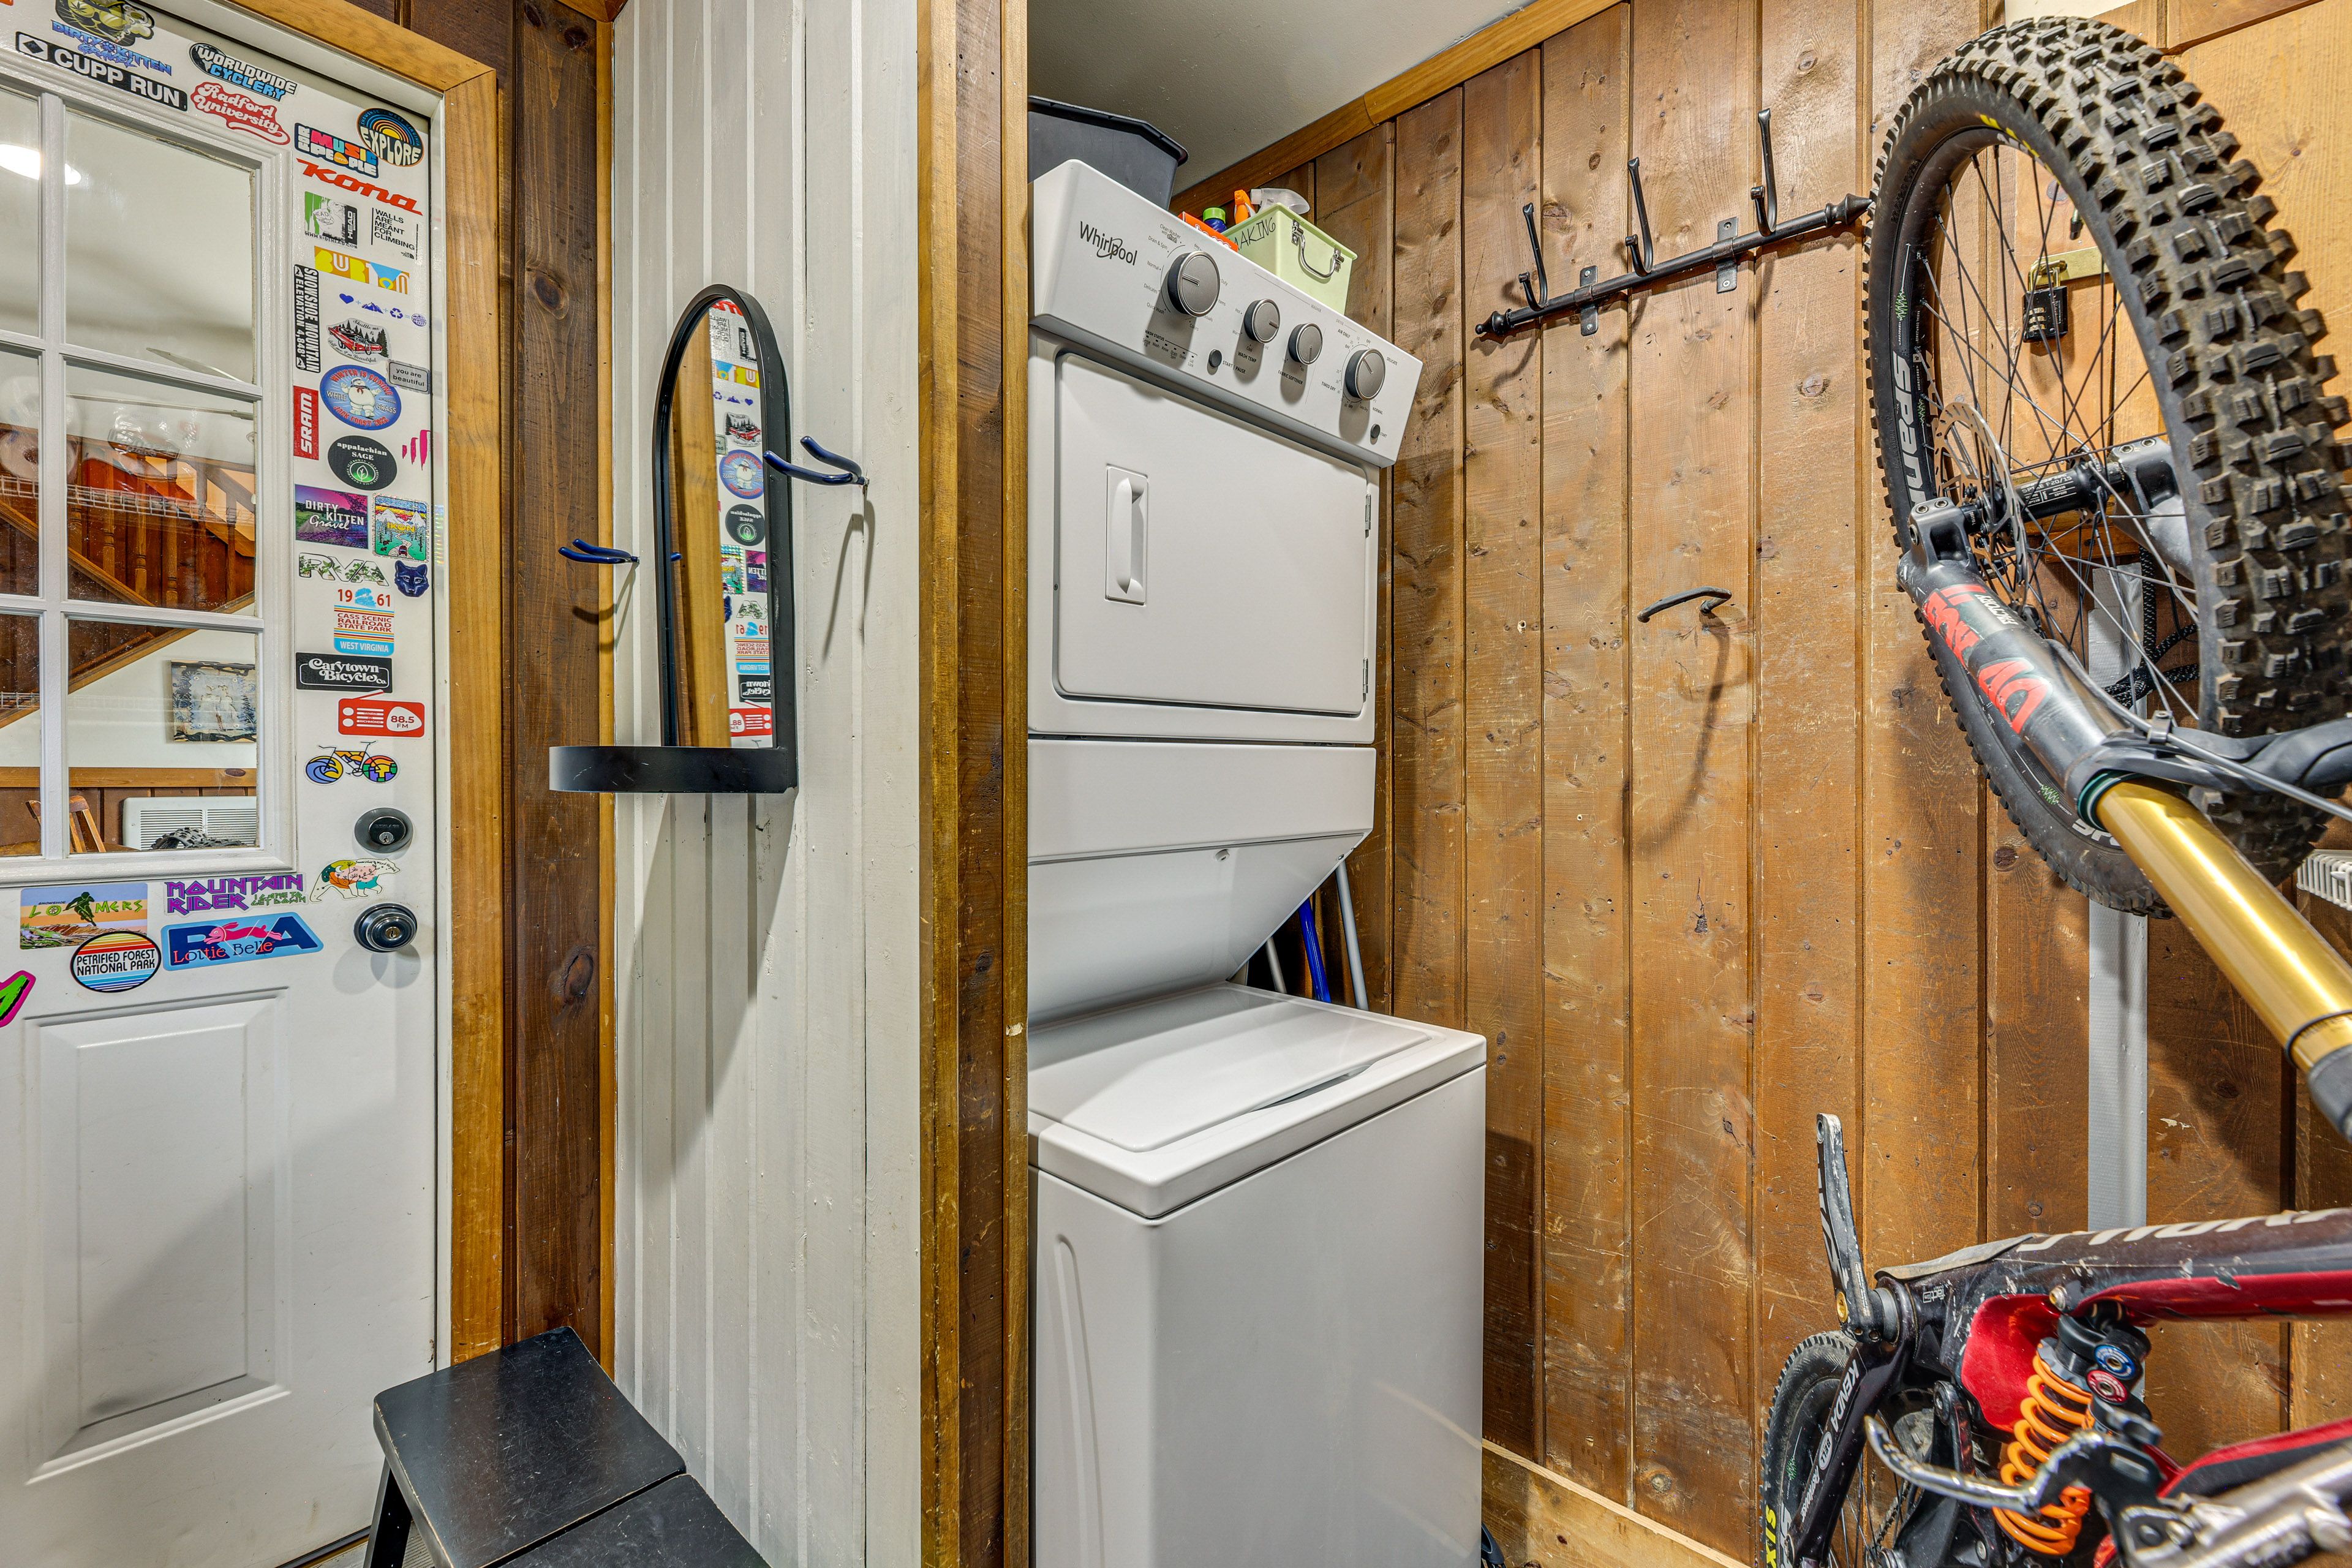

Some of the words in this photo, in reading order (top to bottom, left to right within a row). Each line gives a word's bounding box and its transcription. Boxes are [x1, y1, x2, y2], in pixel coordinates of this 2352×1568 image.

[50, 19, 103, 45] DIRTY
[116, 45, 172, 76] KITTEN
[197, 45, 297, 94] WORLDWIDE
[55, 48, 123, 84] CUPP
[130, 75, 179, 107] RUN
[209, 64, 285, 101] CYCLERY
[197, 83, 274, 118] Radford
[193, 95, 279, 135] University
[311, 130, 377, 166] MUSIC
[360, 126, 421, 166] EXPLORE
[375, 209, 404, 224] WALLS
[375, 216, 393, 225] ARE
[375, 221, 404, 235] MEANT
[375, 226, 391, 236] FOR
[1159, 224, 1169, 232] Clean
[1169, 228, 1181, 239] Washer
[374, 232, 415, 250] CLIMBING
[1080, 221, 1138, 266] Whirlpool
[1147, 260, 1159, 271] Normal
[304, 268, 318, 321] SNOWSHOE
[1144, 283, 1158, 294] Delicates
[296, 278, 304, 327] ELEVATION
[1311, 304, 1322, 313] WASHER
[353, 320, 371, 330] Shuttle
[306, 323, 320, 373] MOUNTAIN
[1238, 352, 1248, 360] WASH
[1386, 356, 1398, 366] DELICATE
[331, 369, 358, 382] WINTER
[369, 374, 393, 395] COMING
[393, 375, 424, 386] beautiful
[1278, 370, 1288, 379] FABRIC
[1288, 374, 1303, 385] SOFTENER
[326, 391, 347, 402] WHITE
[333, 406, 350, 419] JACK
[350, 417, 372, 426] FROST
[375, 404, 397, 413] GRASS
[1372, 407, 1383, 415] NORMAL
[300, 393, 312, 454] SRAM
[337, 442, 387, 456] appalachian
[352, 451, 374, 461] SAGE
[2046, 476, 2073, 486] F20/15
[305, 500, 338, 513] DIRTY
[309, 514, 350, 530] Gravel
[326, 511, 364, 526] KITTEN
[387, 522, 415, 532] IKON
[299, 552, 390, 587] RVA
[337, 589, 353, 602] 19
[377, 594, 391, 607] 61
[1973, 594, 2019, 625] FACTORY
[337, 618, 391, 628] RAILROAD
[340, 641, 358, 650] WEST
[360, 643, 389, 652] VIRGINIA
[308, 658, 379, 673] Carytown
[318, 669, 377, 682] Bicycle
[164, 874, 304, 899] MOUNTAIN
[167, 893, 249, 915] RIDER
[251, 898, 270, 907] GET
[273, 895, 306, 905] DOWN
[77, 952, 120, 966] PETRIFIED
[123, 949, 156, 962] FOREST
[173, 948, 226, 963] Lottie
[233, 940, 273, 956] Belle
[77, 959, 127, 976] NATIONAL
[130, 957, 156, 970] PARK
[1931, 1288, 1946, 1302] fact
[1830, 1359, 1860, 1433] KENDA
[1820, 1438, 1831, 1464] BELL
